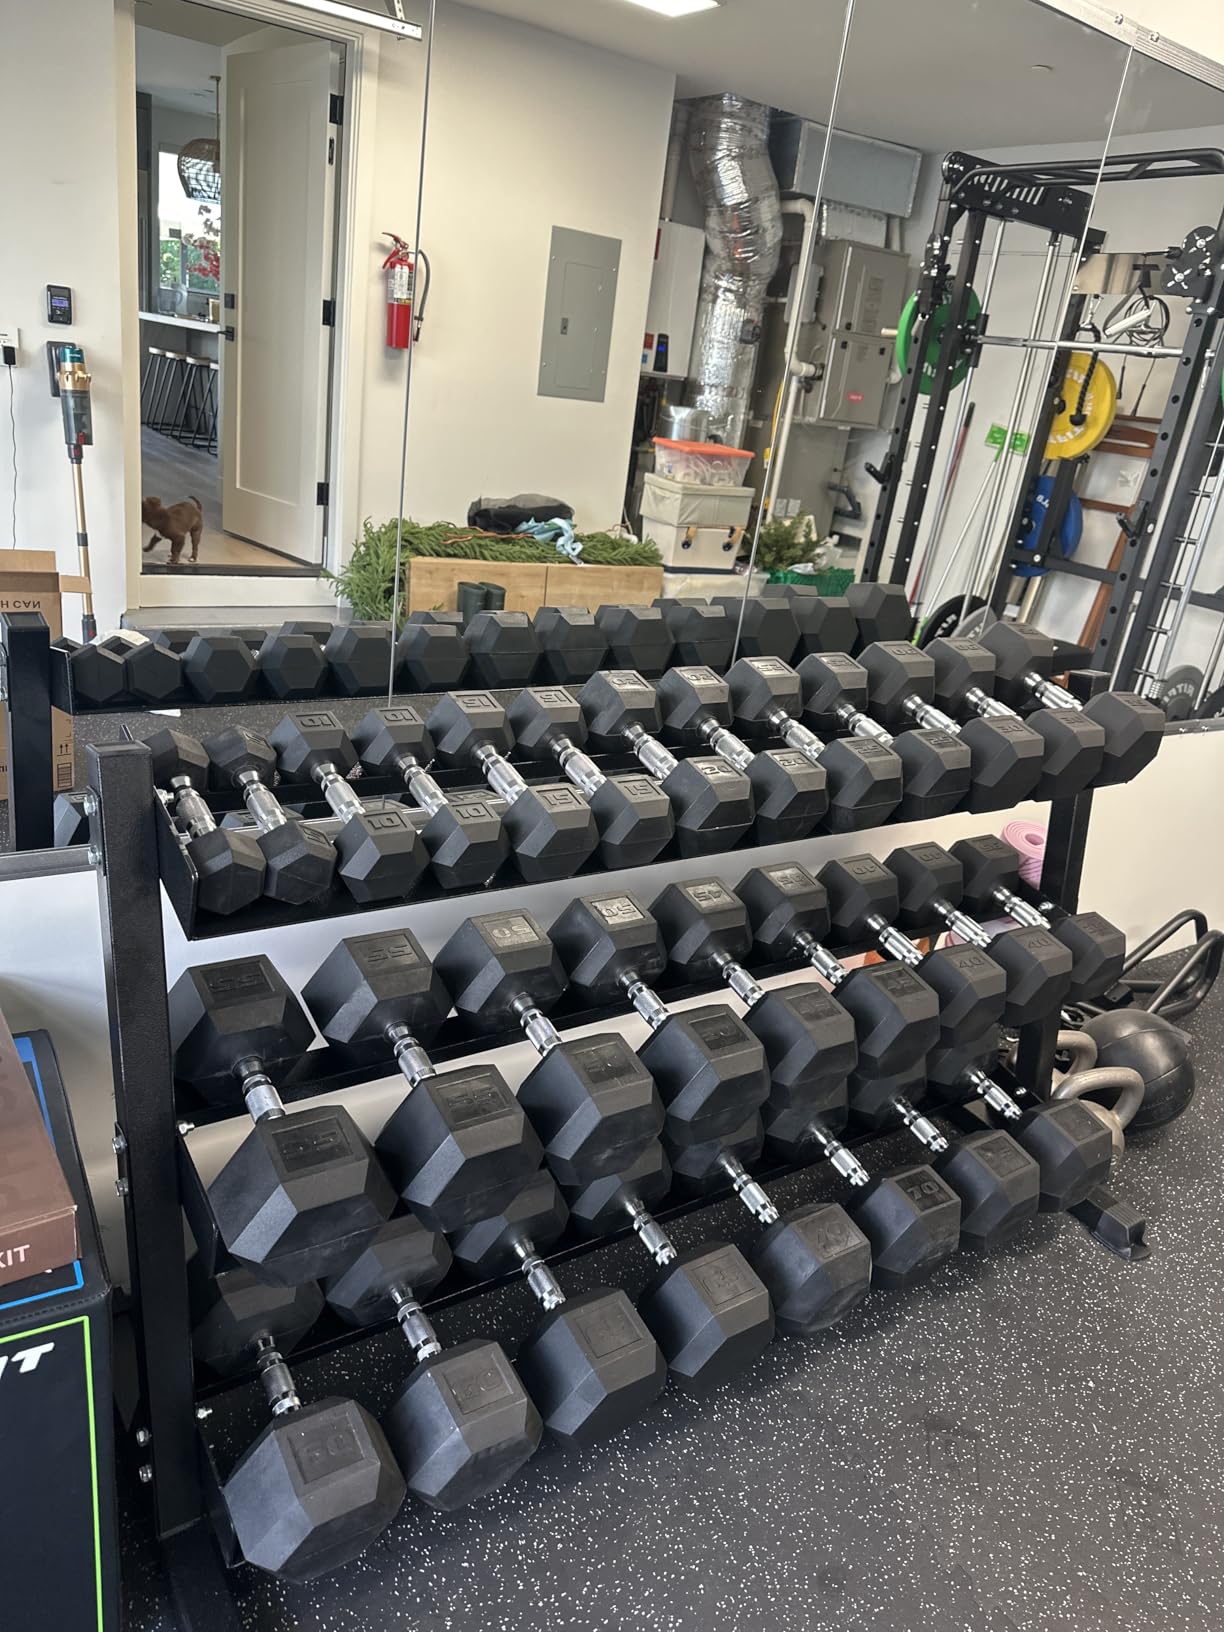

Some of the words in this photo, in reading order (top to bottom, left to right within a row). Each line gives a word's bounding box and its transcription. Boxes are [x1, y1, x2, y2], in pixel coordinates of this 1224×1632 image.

[611, 677, 641, 686] 20
[686, 673, 714, 682] 20
[462, 698, 490, 709] 15
[538, 693, 566, 704] 15
[300, 715, 333, 729] 10
[384, 710, 414, 722] 10
[997, 725, 1024, 734] 30
[928, 736, 954, 745] 25
[780, 757, 808, 767] 20
[701, 765, 732, 775] 20
[623, 783, 653, 796] 15
[543, 793, 572, 806] 15
[456, 808, 487, 819] 10
[368, 817, 400, 830] 10
[918, 851, 946, 861] 40
[851, 862, 881, 875] 40
[692, 888, 723, 901] 45
[600, 903, 636, 918] 50
[492, 923, 532, 939] 50
[1025, 936, 1051, 948] 40
[368, 944, 412, 963] 55
[959, 956, 986, 969] 40
[906, 1181, 939, 1200] 70
